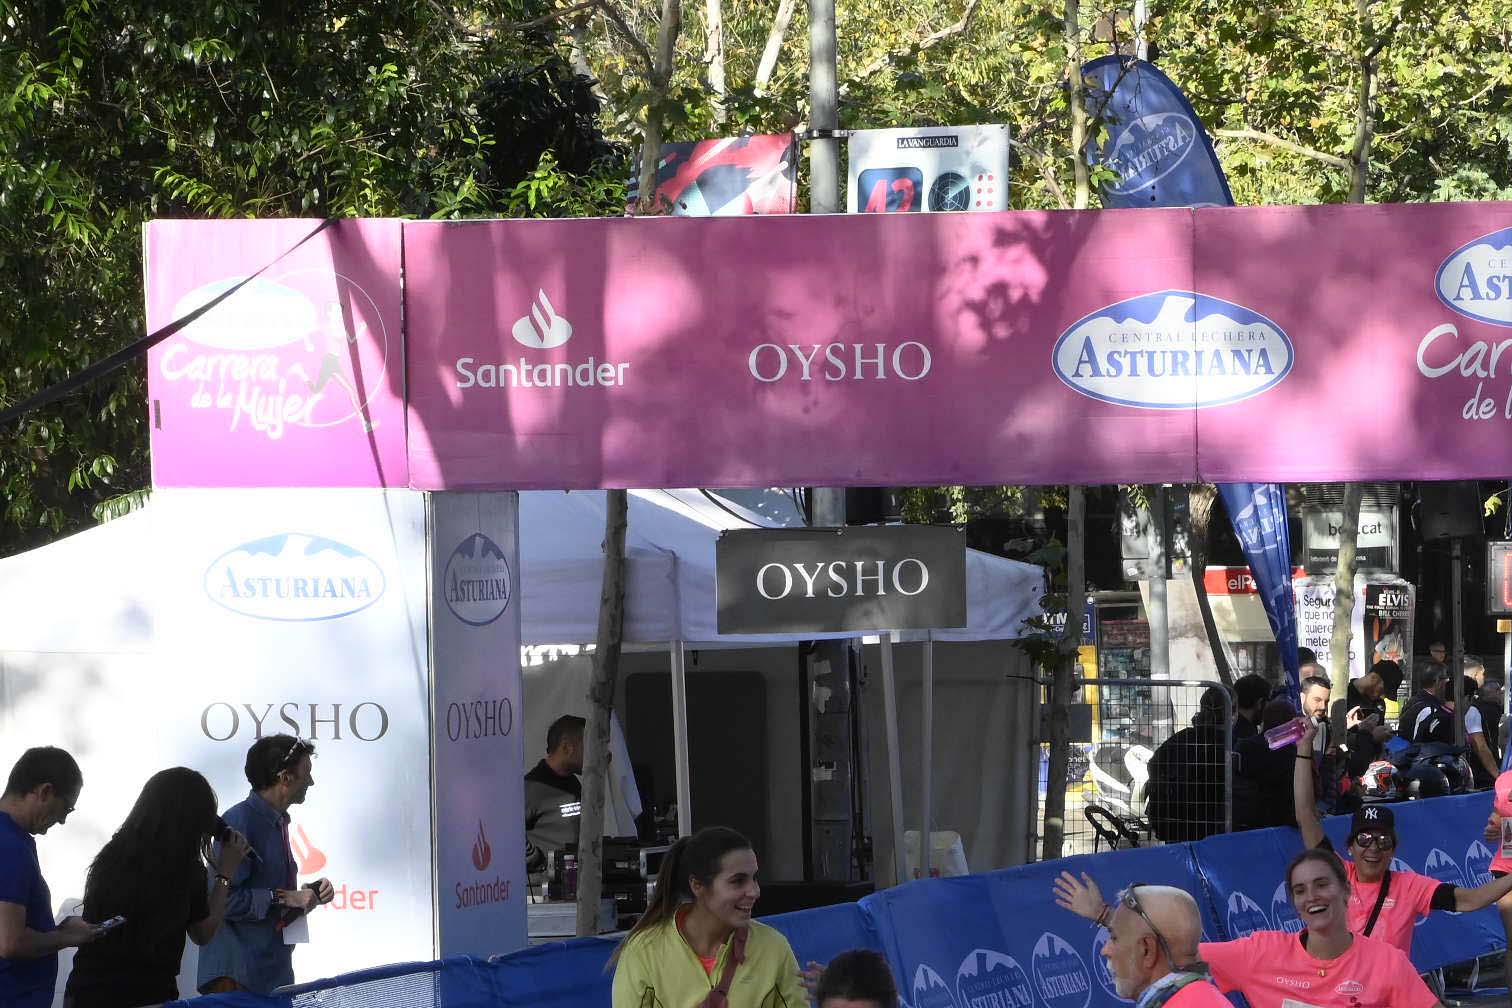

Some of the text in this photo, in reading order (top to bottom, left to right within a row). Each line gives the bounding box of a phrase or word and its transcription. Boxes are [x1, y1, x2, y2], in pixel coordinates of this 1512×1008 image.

[1108, 329, 1267, 345] CENTRAL LECHERA
[160, 343, 280, 381] Carrera
[456, 356, 630, 389] Santander
[748, 341, 932, 383] OYSHO
[1072, 335, 1276, 379] ASTURIANA
[229, 377, 325, 440] Mujer
[1462, 382, 1497, 420] de
[221, 565, 371, 599] ASTURIANA
[450, 568, 507, 602] ASTURIANA
[756, 558, 929, 600] OYSHO
[1304, 611, 1320, 621] que
[1378, 594, 1408, 606] ELVIS
[200, 702, 389, 742] OYSHO
[447, 697, 512, 742] OYSHO
[456, 878, 511, 910] Santander
[1037, 968, 1089, 1000] ASTURIANA
[1276, 976, 1310, 989] OYSHO
